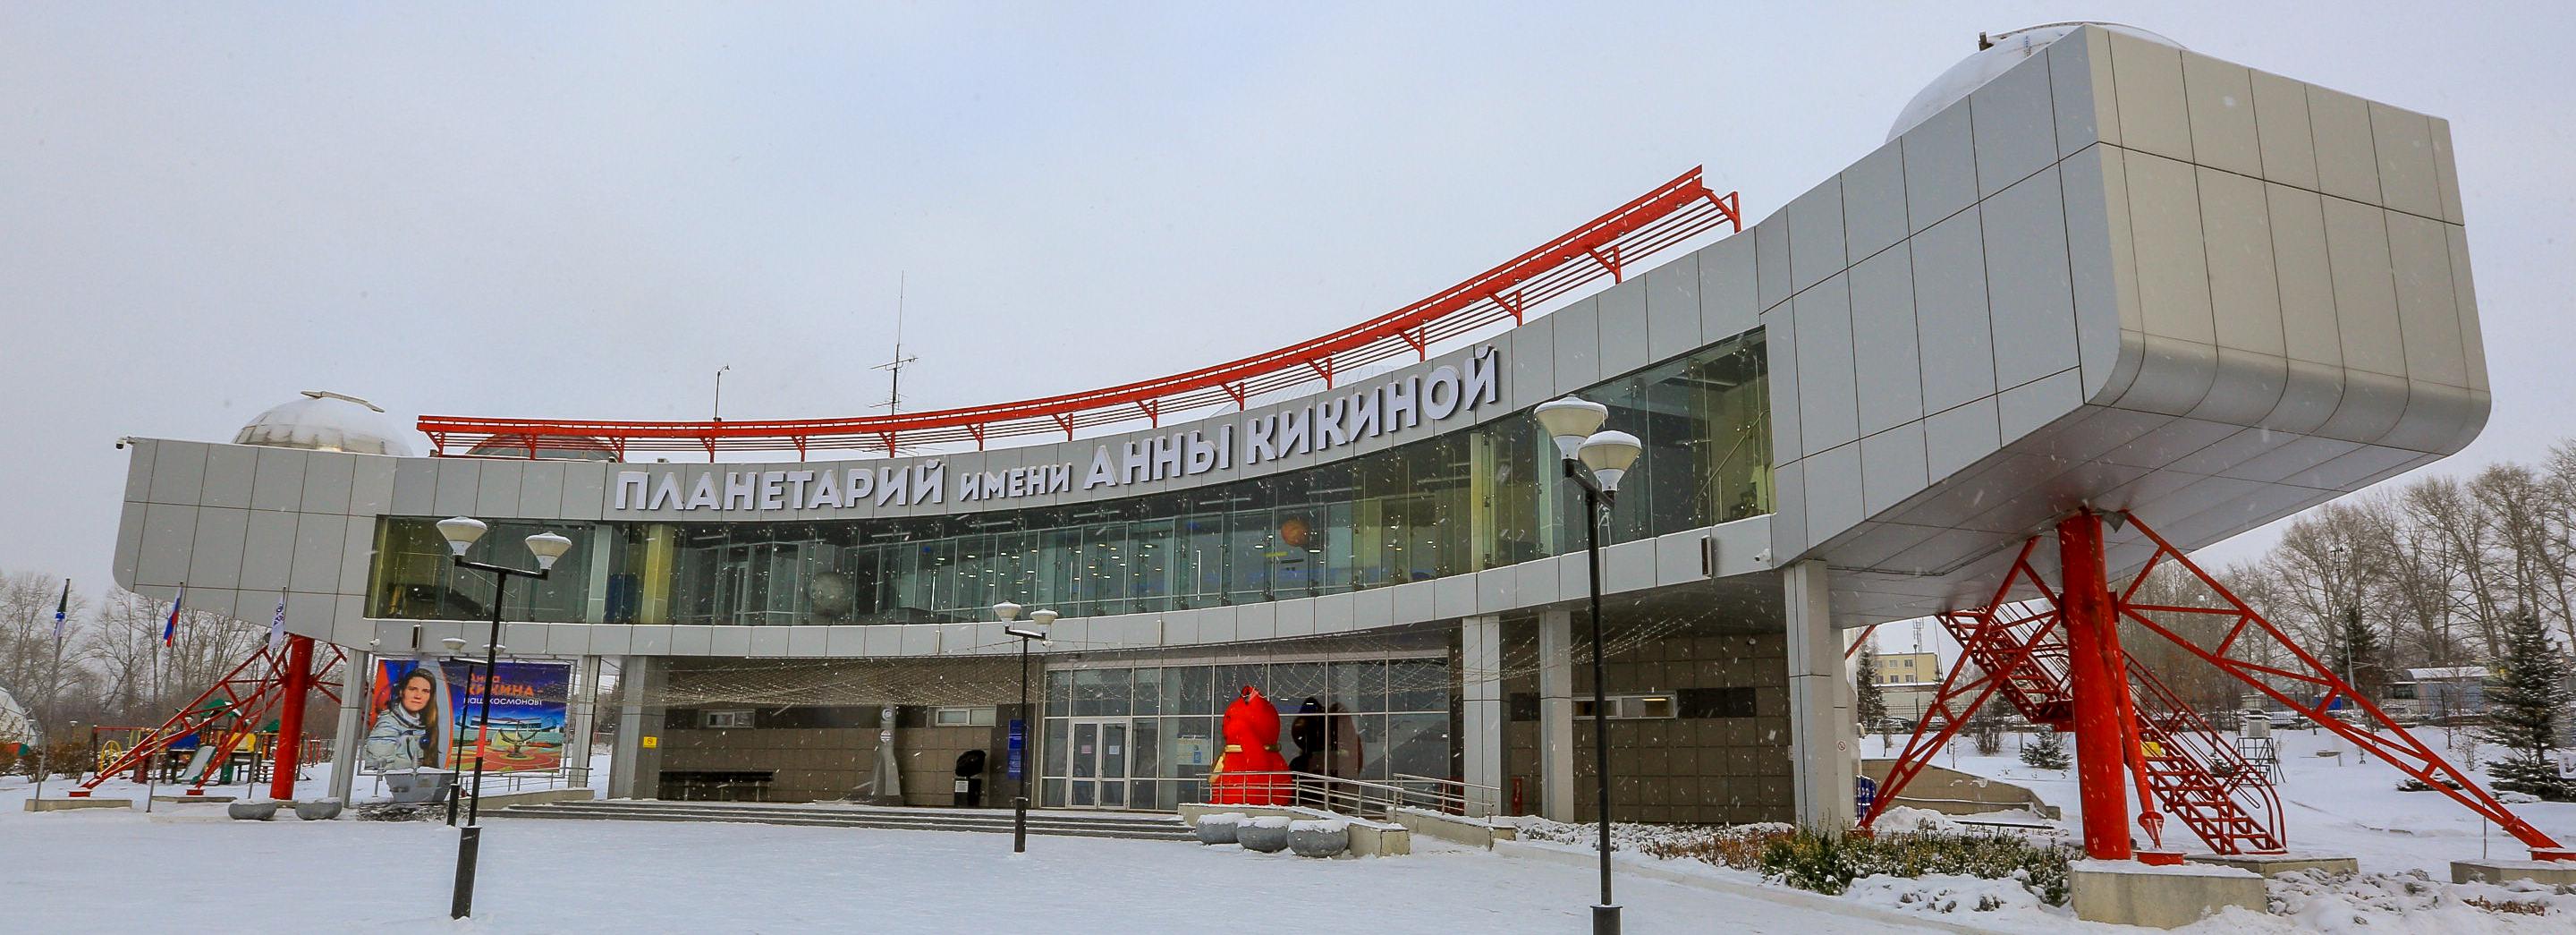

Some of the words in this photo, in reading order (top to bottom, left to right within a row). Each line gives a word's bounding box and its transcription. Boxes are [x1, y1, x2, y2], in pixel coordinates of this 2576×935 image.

[614, 458, 945, 511] ПЛАНЕТАРИЙ
[960, 462, 1072, 502] ИМЕНИ
[1082, 424, 1233, 490] АННЫ
[1246, 344, 1499, 465] КИКИНОЙ
